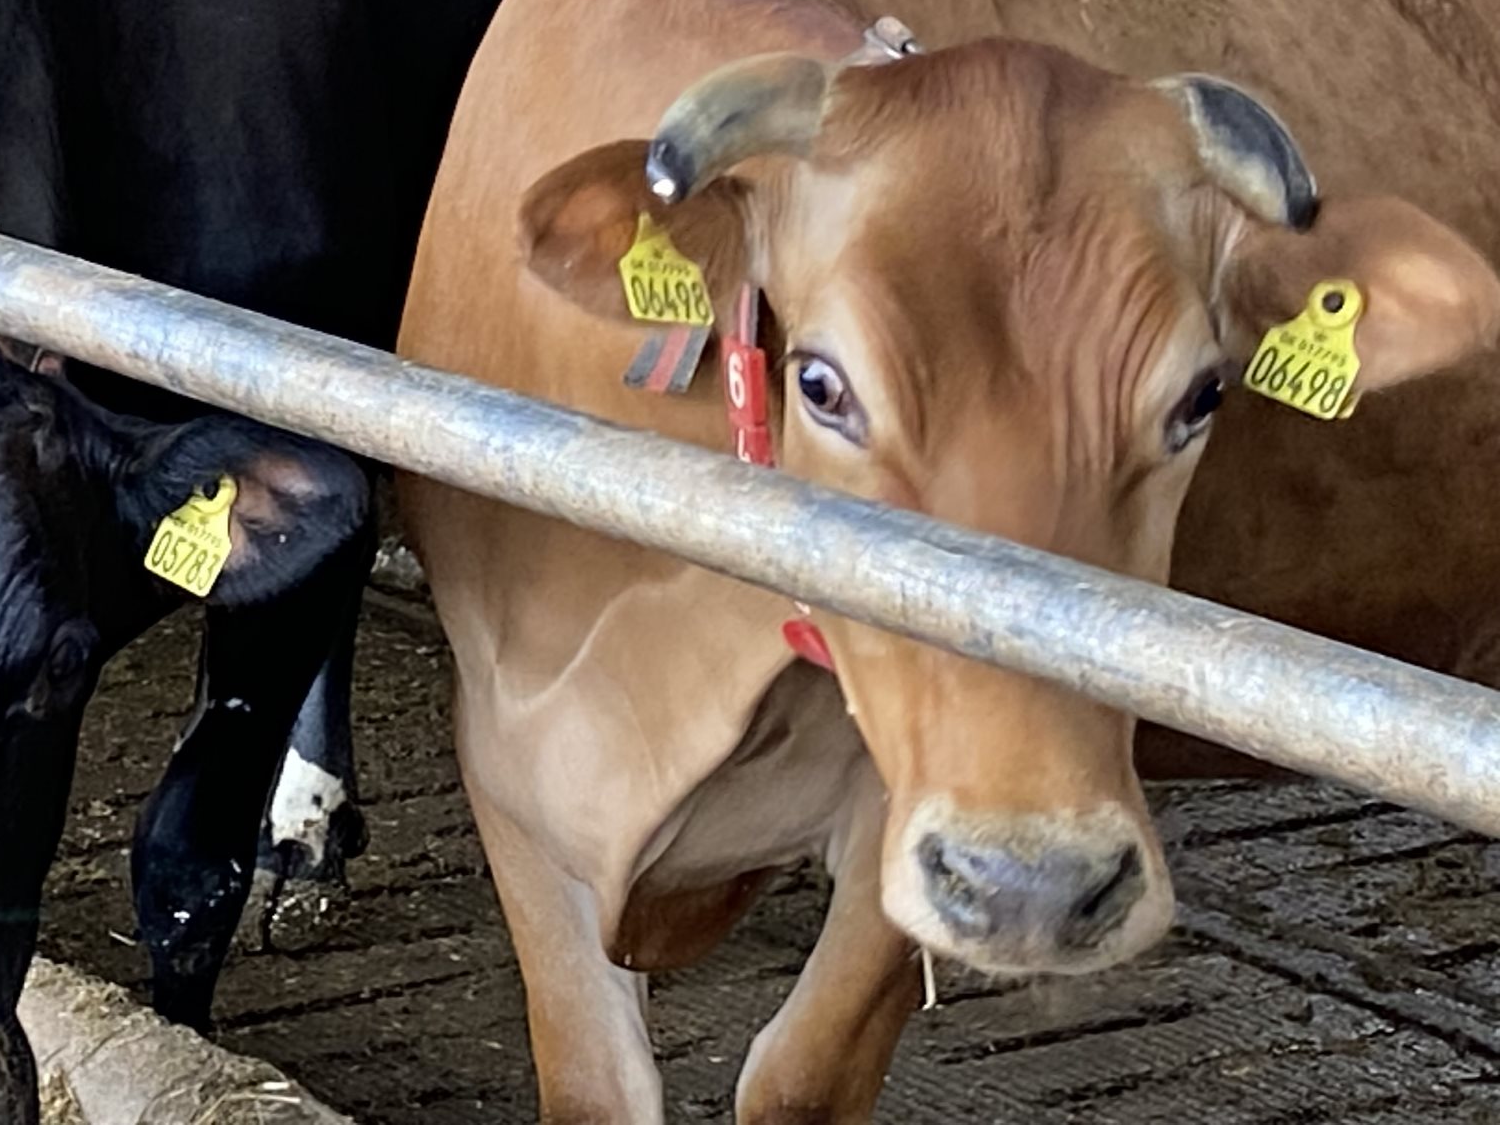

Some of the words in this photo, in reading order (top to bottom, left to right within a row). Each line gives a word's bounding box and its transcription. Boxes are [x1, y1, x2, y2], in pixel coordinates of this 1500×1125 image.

[631, 275, 710, 322] 06498
[1251, 346, 1346, 413] 06498
[152, 530, 221, 591] 05783
